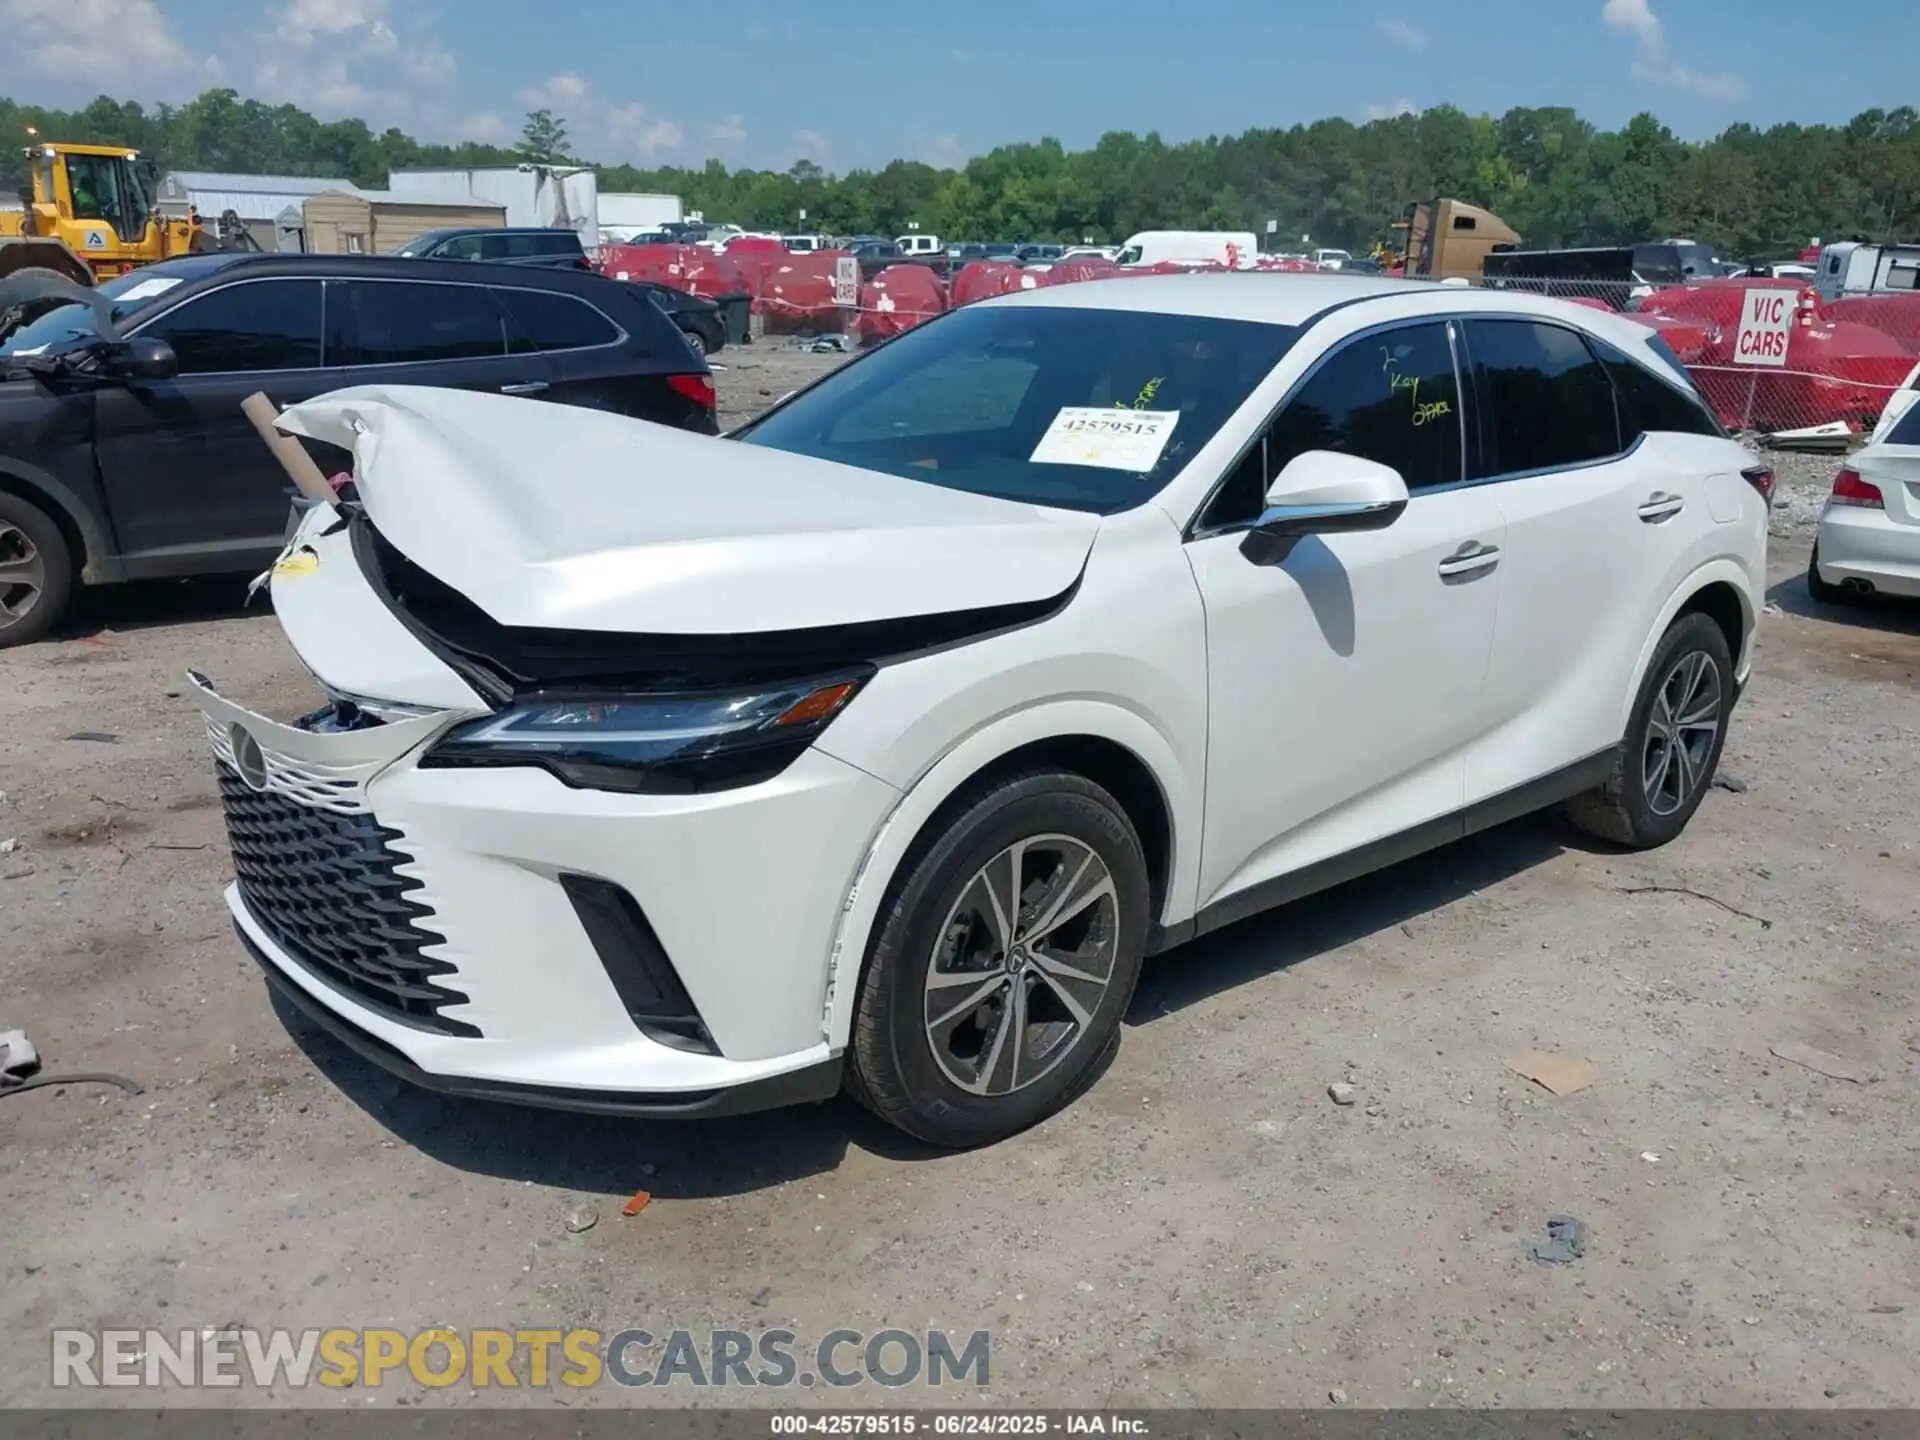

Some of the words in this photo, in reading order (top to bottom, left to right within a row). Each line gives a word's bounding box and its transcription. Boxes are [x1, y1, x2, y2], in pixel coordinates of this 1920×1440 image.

[1753, 297, 1784, 324] VIC
[1740, 330, 1785, 357] CARS
[1062, 419, 1158, 435] 42579515
